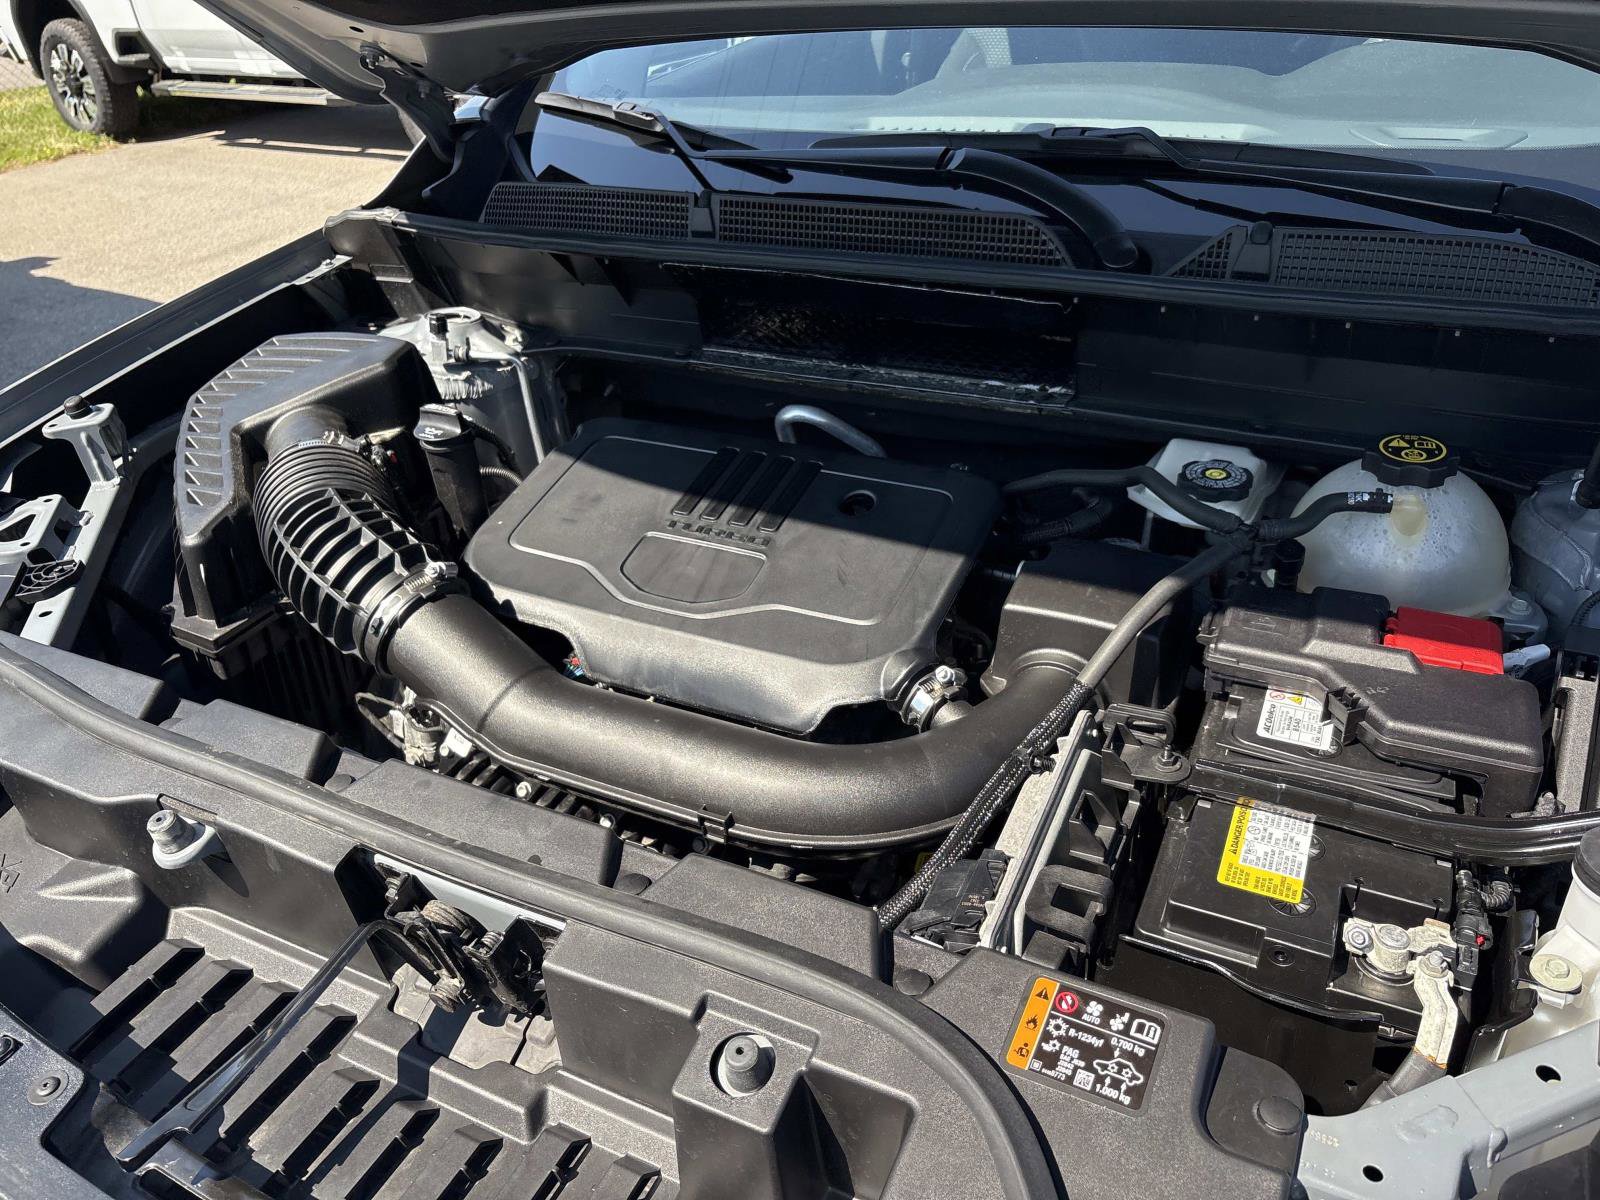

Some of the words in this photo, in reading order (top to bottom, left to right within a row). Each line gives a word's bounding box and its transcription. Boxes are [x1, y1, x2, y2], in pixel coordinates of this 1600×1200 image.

[667, 520, 771, 548] TURBO
[1263, 703, 1276, 734] ACDelco
[1081, 1014, 1100, 1024] AUTO
[1068, 1028, 1104, 1047] R-1234yf
[1111, 1037, 1134, 1052] 0.700
[1134, 1042, 1145, 1057] kg
[1061, 1045, 1080, 1059] PAG
[1095, 1083, 1119, 1099] 1.000
[1118, 1089, 1131, 1105] kg
